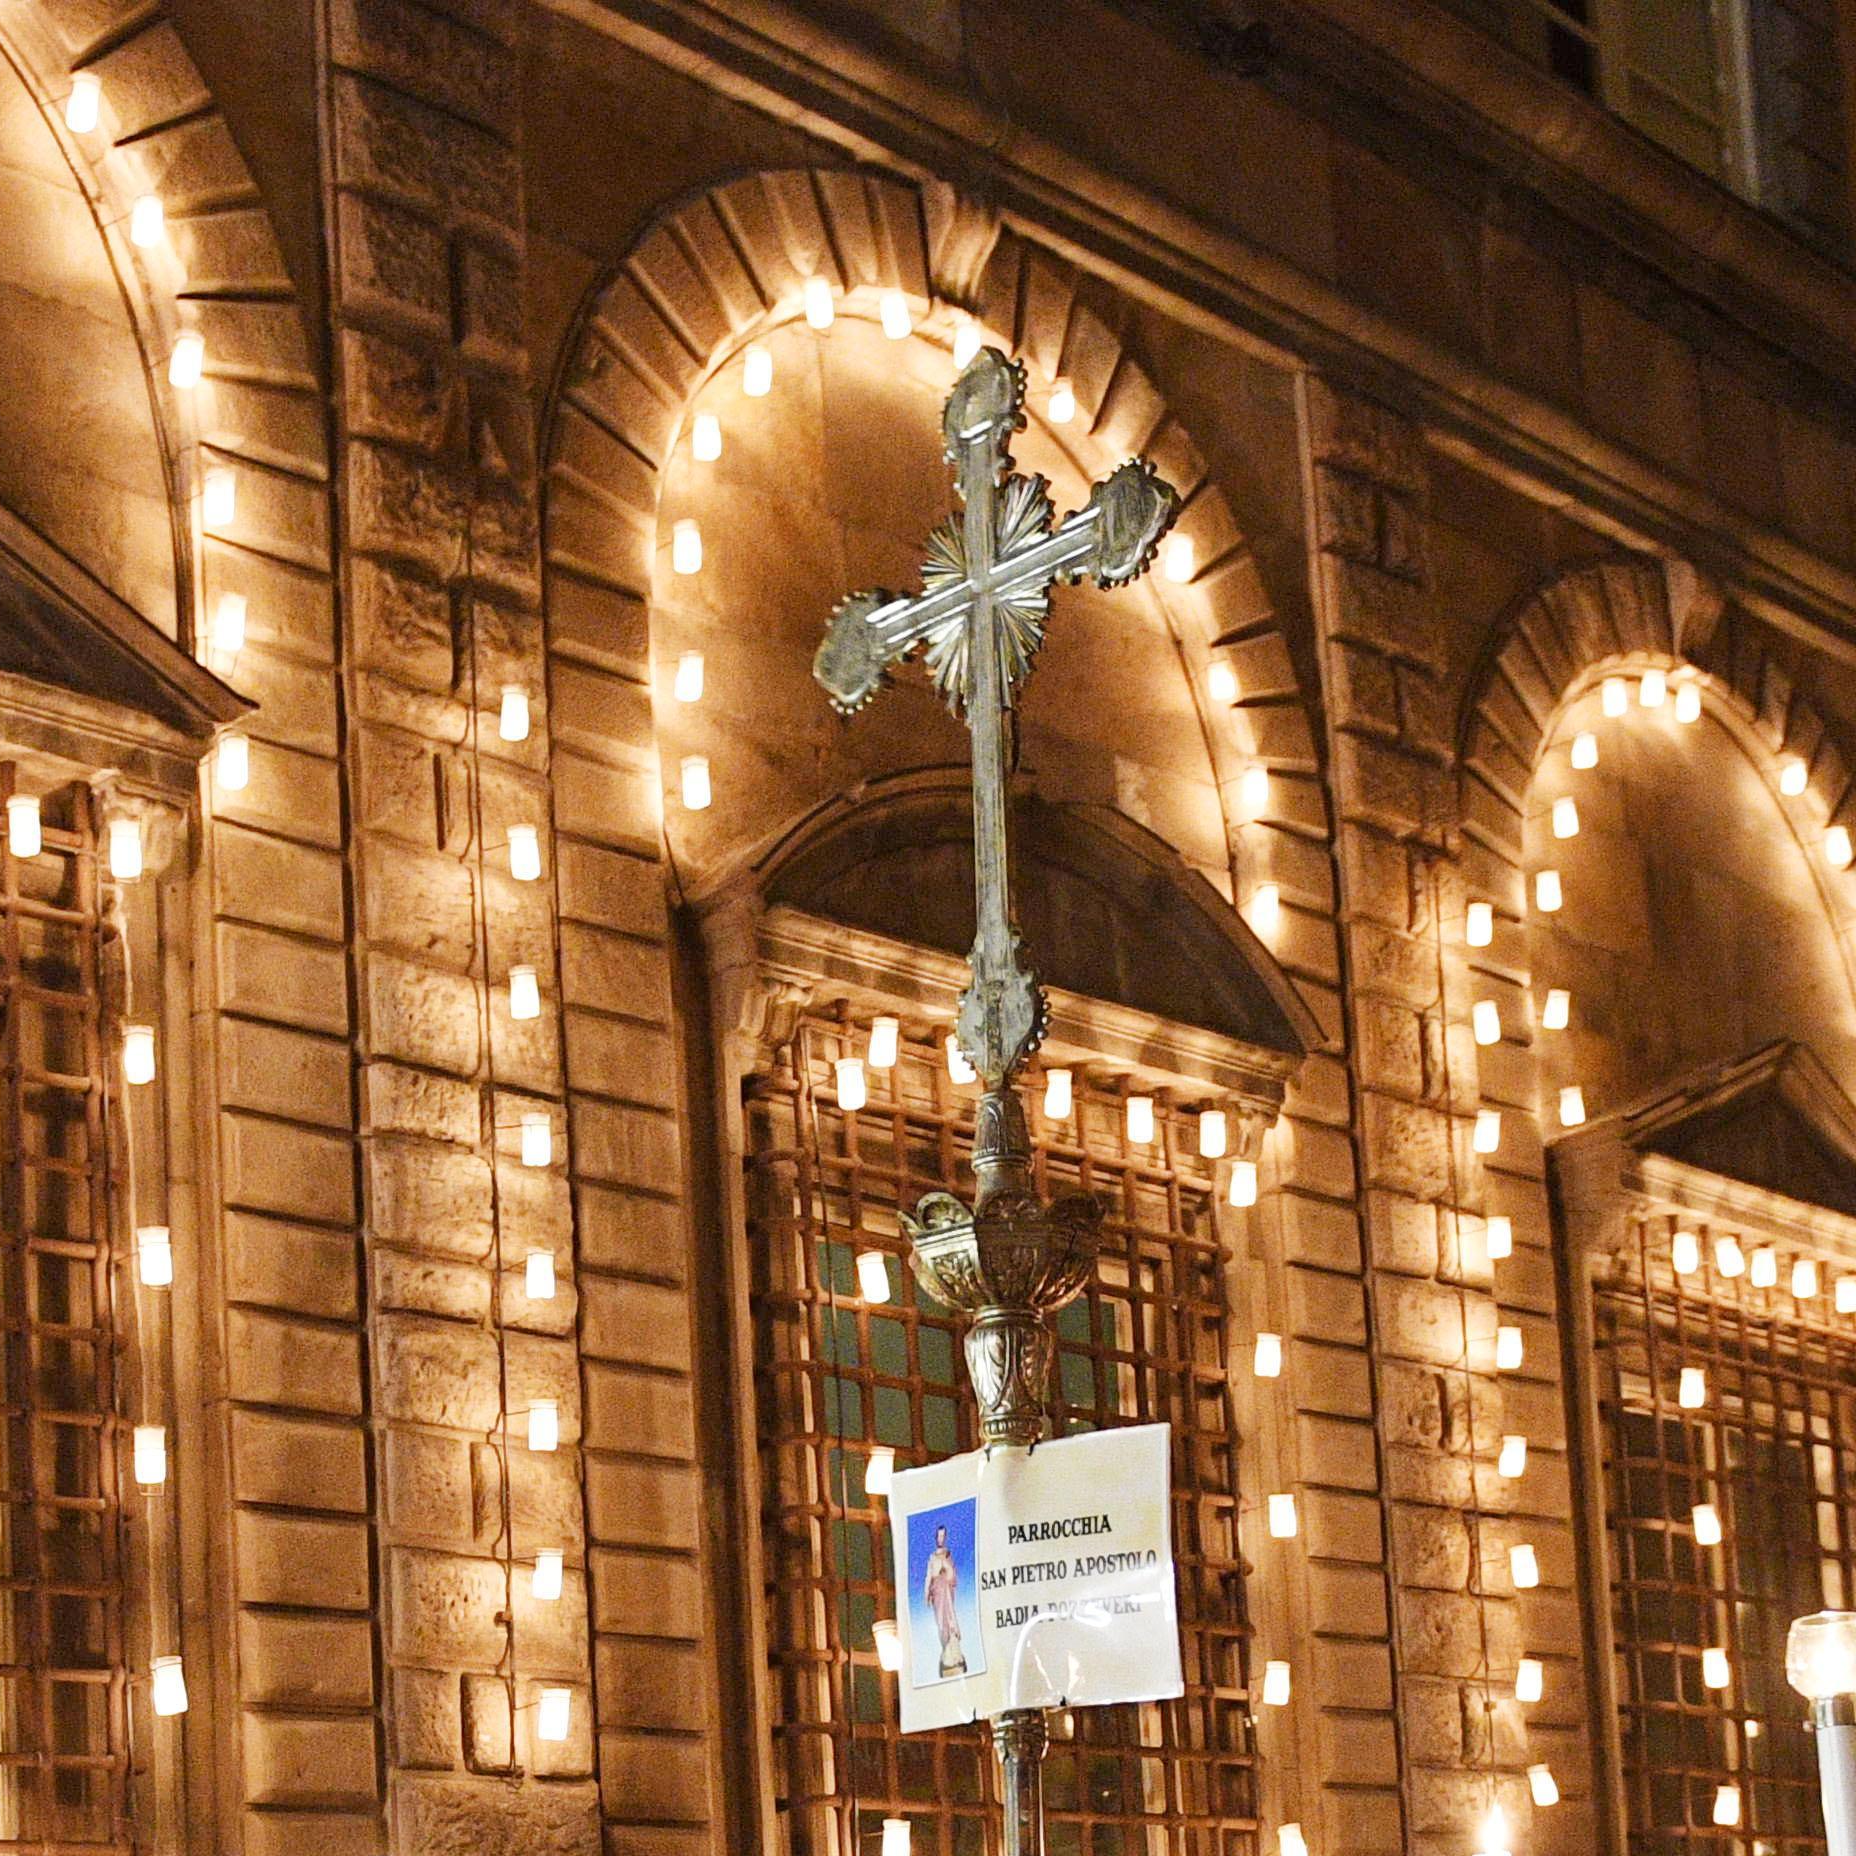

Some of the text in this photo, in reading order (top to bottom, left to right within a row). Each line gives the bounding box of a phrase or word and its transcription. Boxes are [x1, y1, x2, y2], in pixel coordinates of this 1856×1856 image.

[1008, 1514, 1113, 1545] PARROCCHIA
[980, 1549, 1157, 1591] SAN PIETRO APOSTOLO
